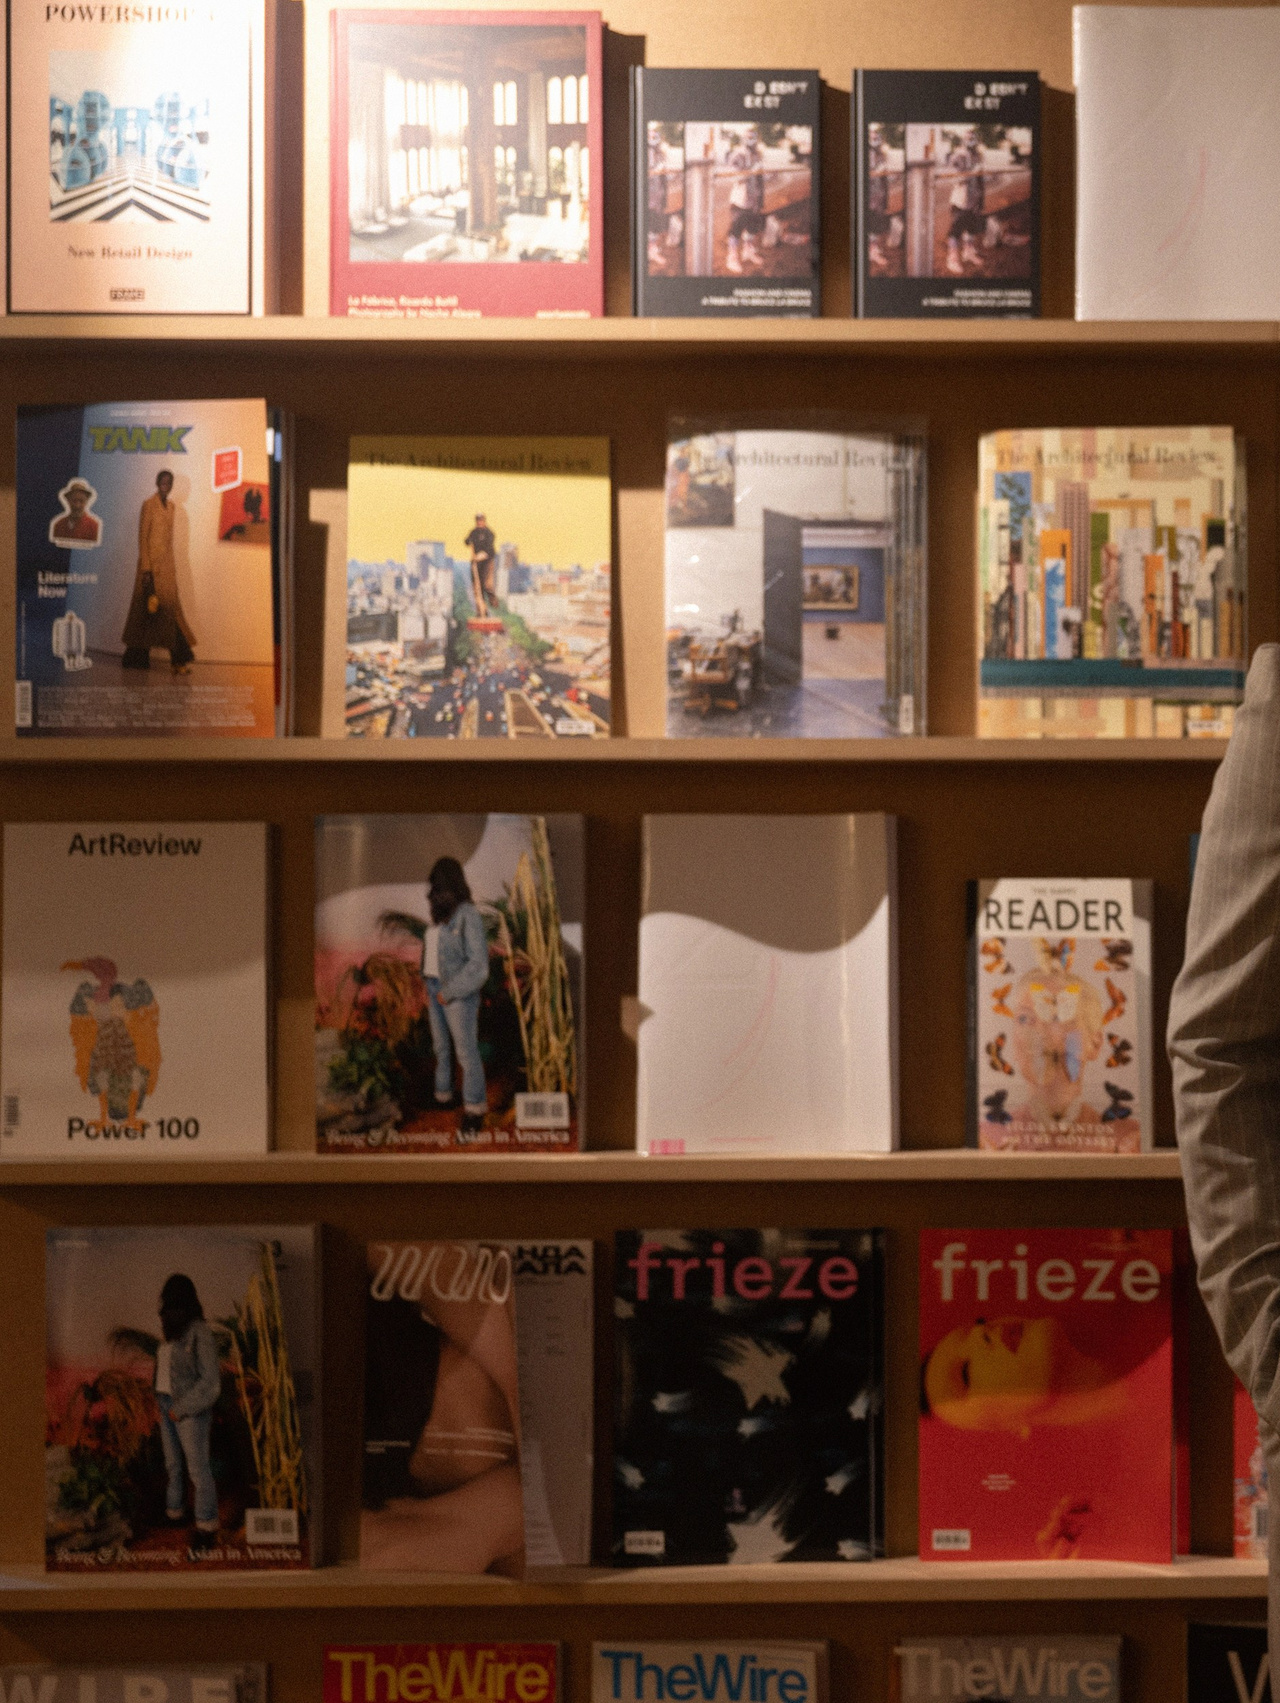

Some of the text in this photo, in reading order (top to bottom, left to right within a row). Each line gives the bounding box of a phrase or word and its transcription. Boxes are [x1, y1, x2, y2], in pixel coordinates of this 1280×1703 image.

[101, 245, 142, 260] Retail
[146, 245, 193, 261] Design
[89, 425, 193, 454] TANK
[37, 570, 98, 585] Literature
[37, 585, 68, 599] Now
[68, 832, 202, 856] ArtReview
[984, 898, 1125, 931] READER
[67, 1116, 200, 1141] Power 100
[627, 1241, 860, 1301] frieze
[932, 1243, 1162, 1302] frieze
[329, 1650, 550, 1703] TheWire
[601, 1650, 809, 1703] TheWire
[894, 1647, 1112, 1698] TheWire
